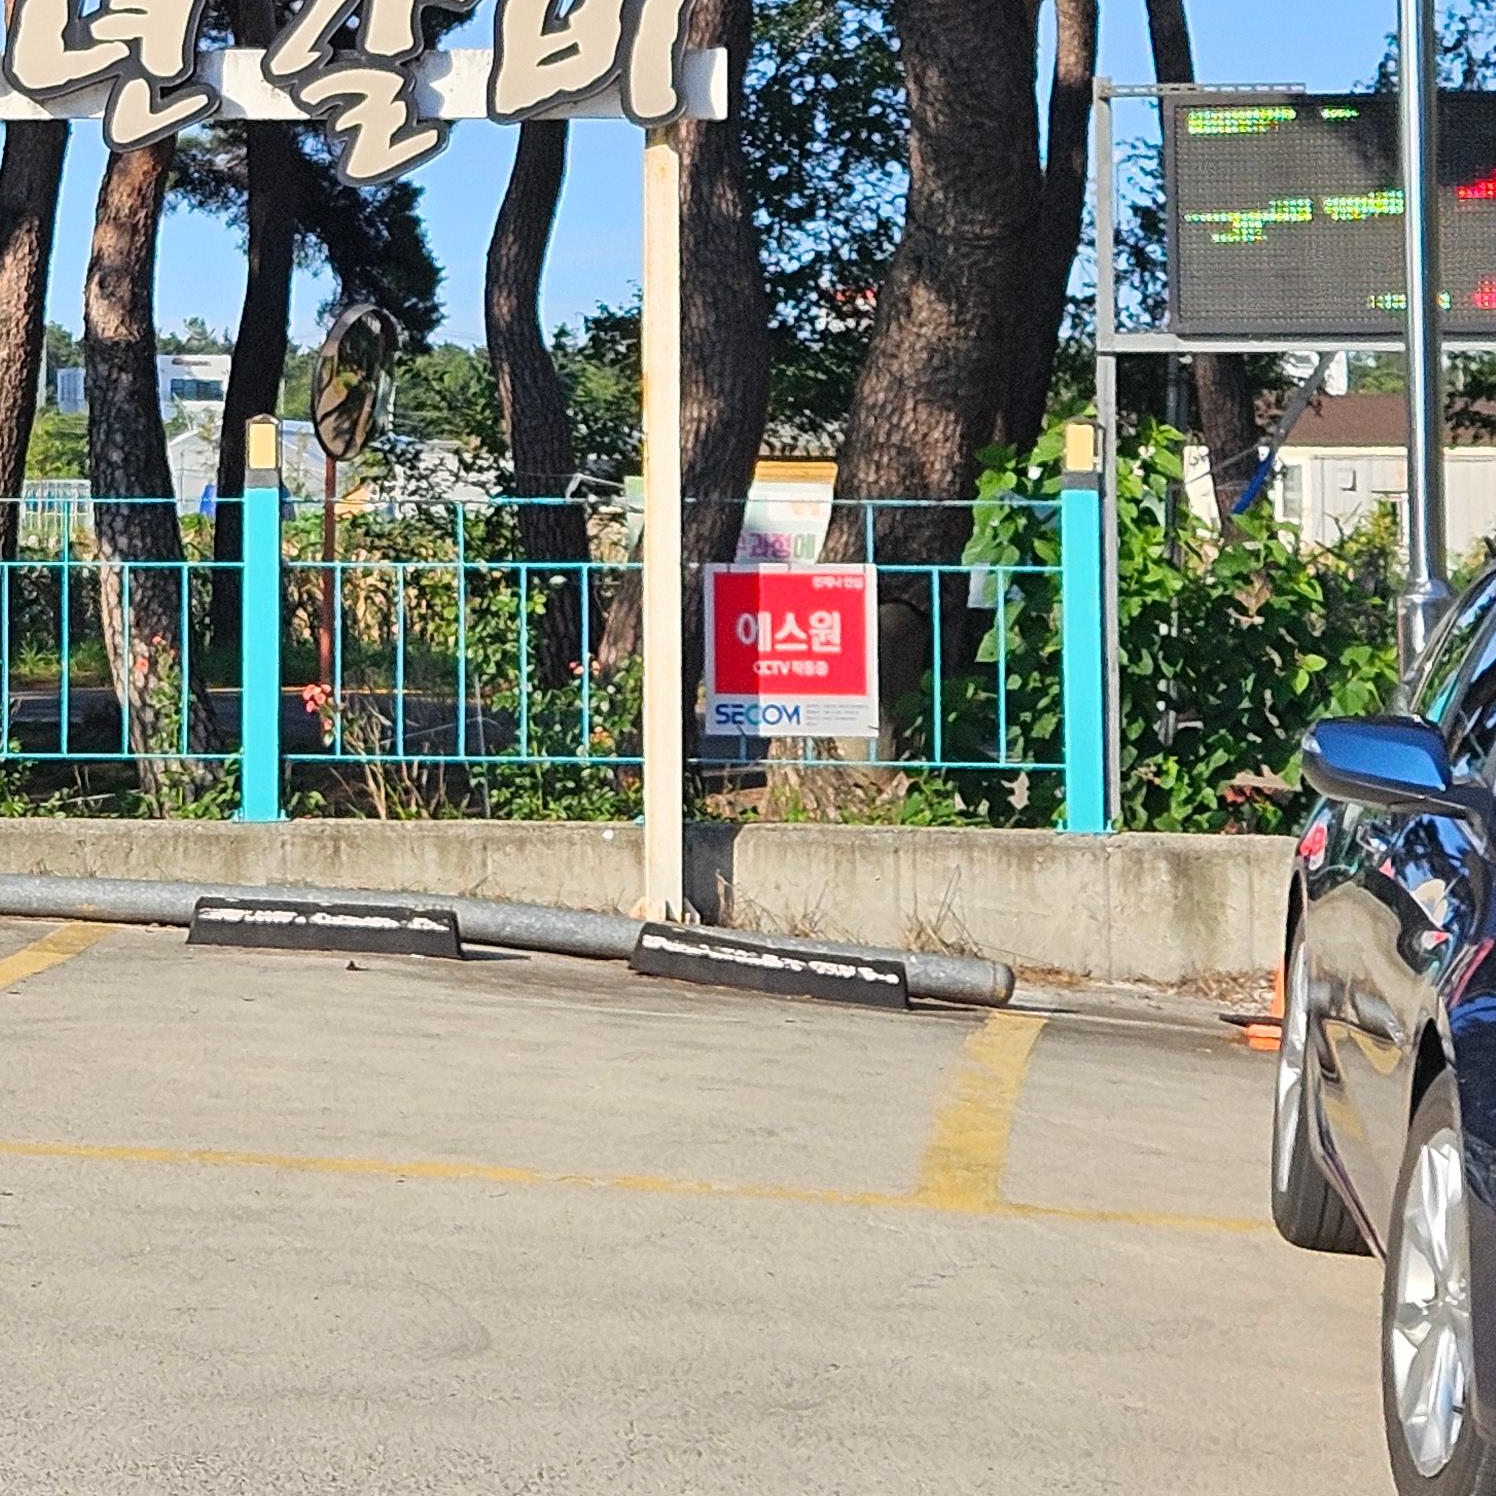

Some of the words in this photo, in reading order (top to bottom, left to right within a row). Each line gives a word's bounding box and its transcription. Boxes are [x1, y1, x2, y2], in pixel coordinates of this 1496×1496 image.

[735, 610, 842, 653] 에스원
[753, 659, 790, 676] CCTV
[715, 703, 801, 726] SECOM
